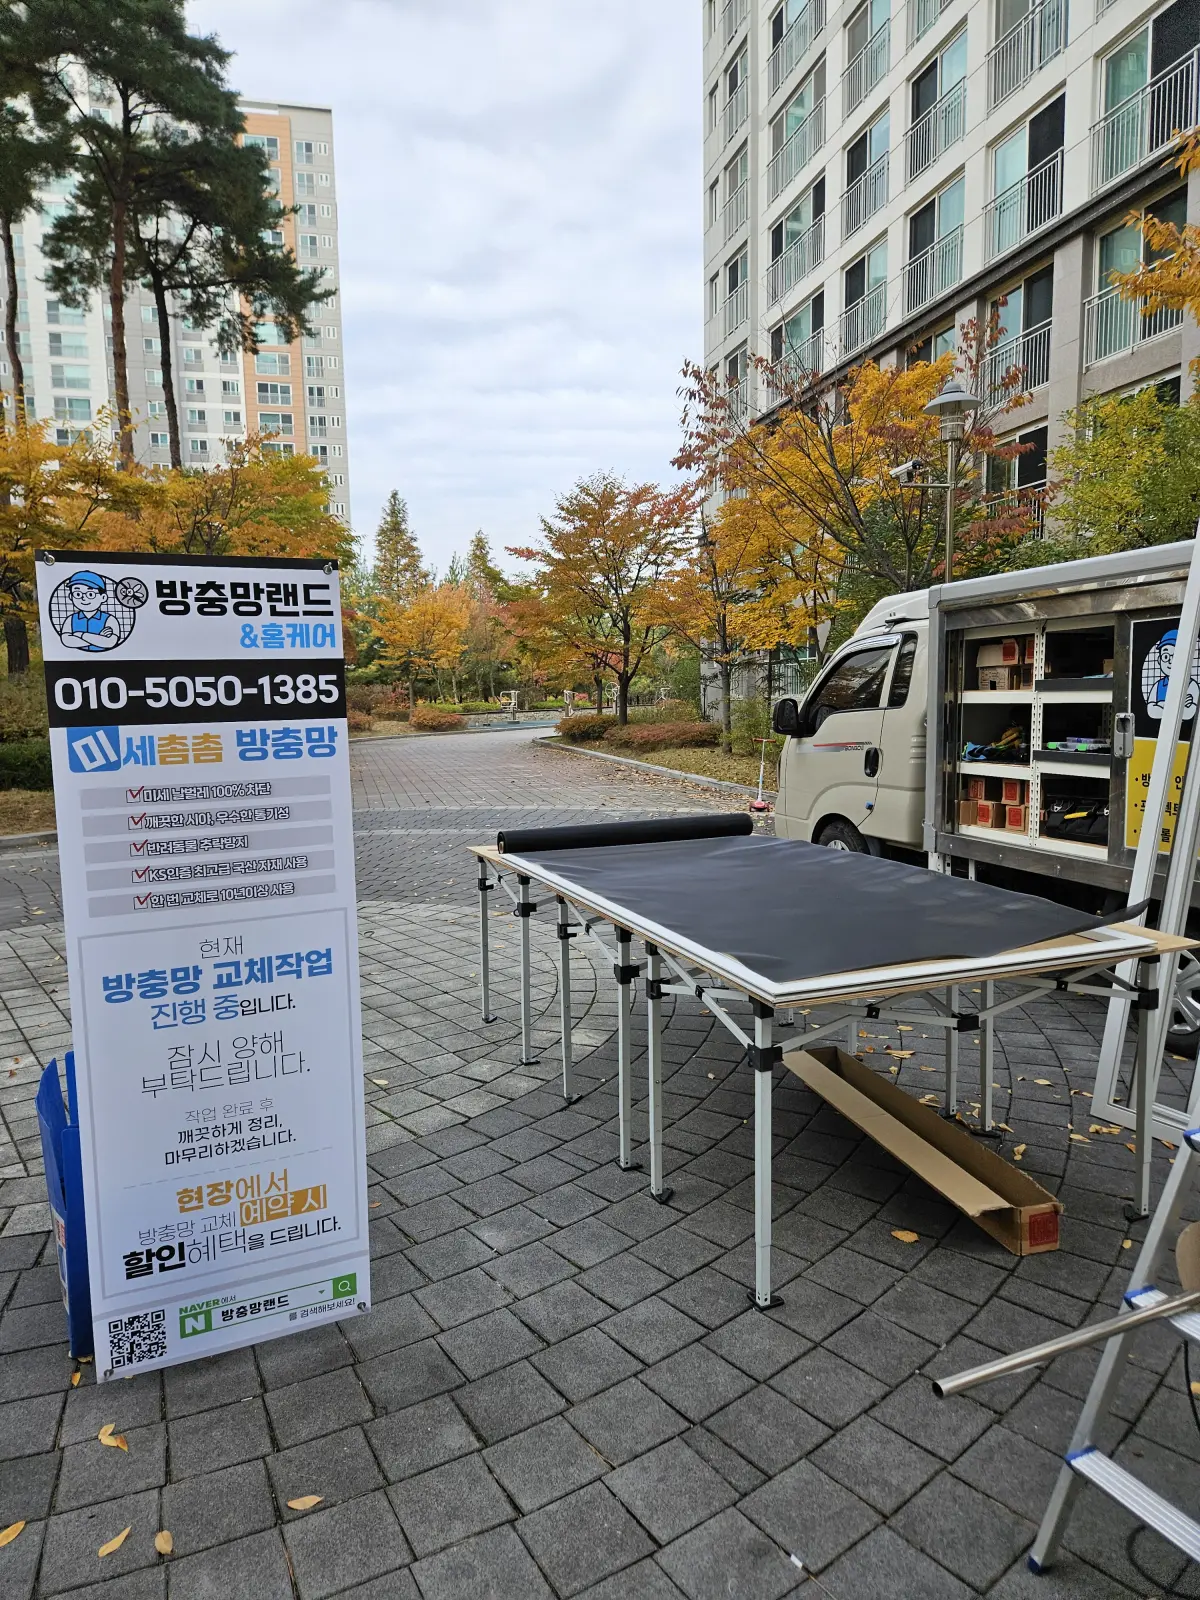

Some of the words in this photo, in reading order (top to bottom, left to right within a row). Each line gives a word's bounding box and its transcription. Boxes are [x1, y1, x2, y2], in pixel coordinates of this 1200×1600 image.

[155, 580, 334, 617] 방충망랜드
[239, 623, 336, 649] &홈케어
[54, 674, 339, 711] 010-5050-1385
[70, 728, 223, 772] 미세촘촘
[236, 725, 338, 762] 방충망
[143, 788, 170, 802] 미세
[171, 786, 210, 801] 날벌레
[211, 784, 245, 799] 100%
[246, 781, 271, 796] 차단
[145, 813, 184, 829] 깨끗한
[186, 812, 214, 827] 시야,
[216, 809, 253, 824] 우수한
[254, 806, 290, 821] 통기성
[147, 839, 198, 855] 반려동물
[199, 835, 248, 851] 추락방지
[149, 867, 191, 882] KS인증
[193, 863, 231, 877] 최고급
[232, 860, 258, 874] 국산
[258, 857, 283, 872] 자재
[284, 855, 308, 869] 사용
[150, 895, 165, 908] 한
[166, 893, 180, 907] 번
[181, 889, 218, 905] 교체로
[220, 884, 269, 901] 10년이상
[270, 881, 295, 896] 사용
[199, 935, 244, 959] 현재
[102, 965, 203, 1004] 방충망
[212, 947, 333, 990] 교체작업
[150, 998, 206, 1030] 진행
[213, 994, 296, 1020] 중입니다.
[167, 1039, 222, 1071] 잠시
[232, 1030, 284, 1060] 양해
[142, 1051, 311, 1098] 부탁드립니다.
[185, 1107, 217, 1124] 작업
[222, 1101, 255, 1119] 완료
[259, 1097, 275, 1112] 후
[177, 1120, 243, 1145] 깨끗하게
[248, 1114, 283, 1132] 정리,
[164, 1129, 297, 1165] 마무리하겠습니다.
[176, 1168, 289, 1213] 현장에서
[138, 1220, 195, 1245] 방충망
[200, 1210, 236, 1233] 교체
[241, 1193, 295, 1226] 예약
[302, 1184, 327, 1212] 시
[122, 1229, 265, 1281] 할인혜택을
[270, 1216, 341, 1246] 드립니다.
[221, 1294, 290, 1322] 방충망랜드
[300, 1298, 355, 1319] 검색해보세요!
